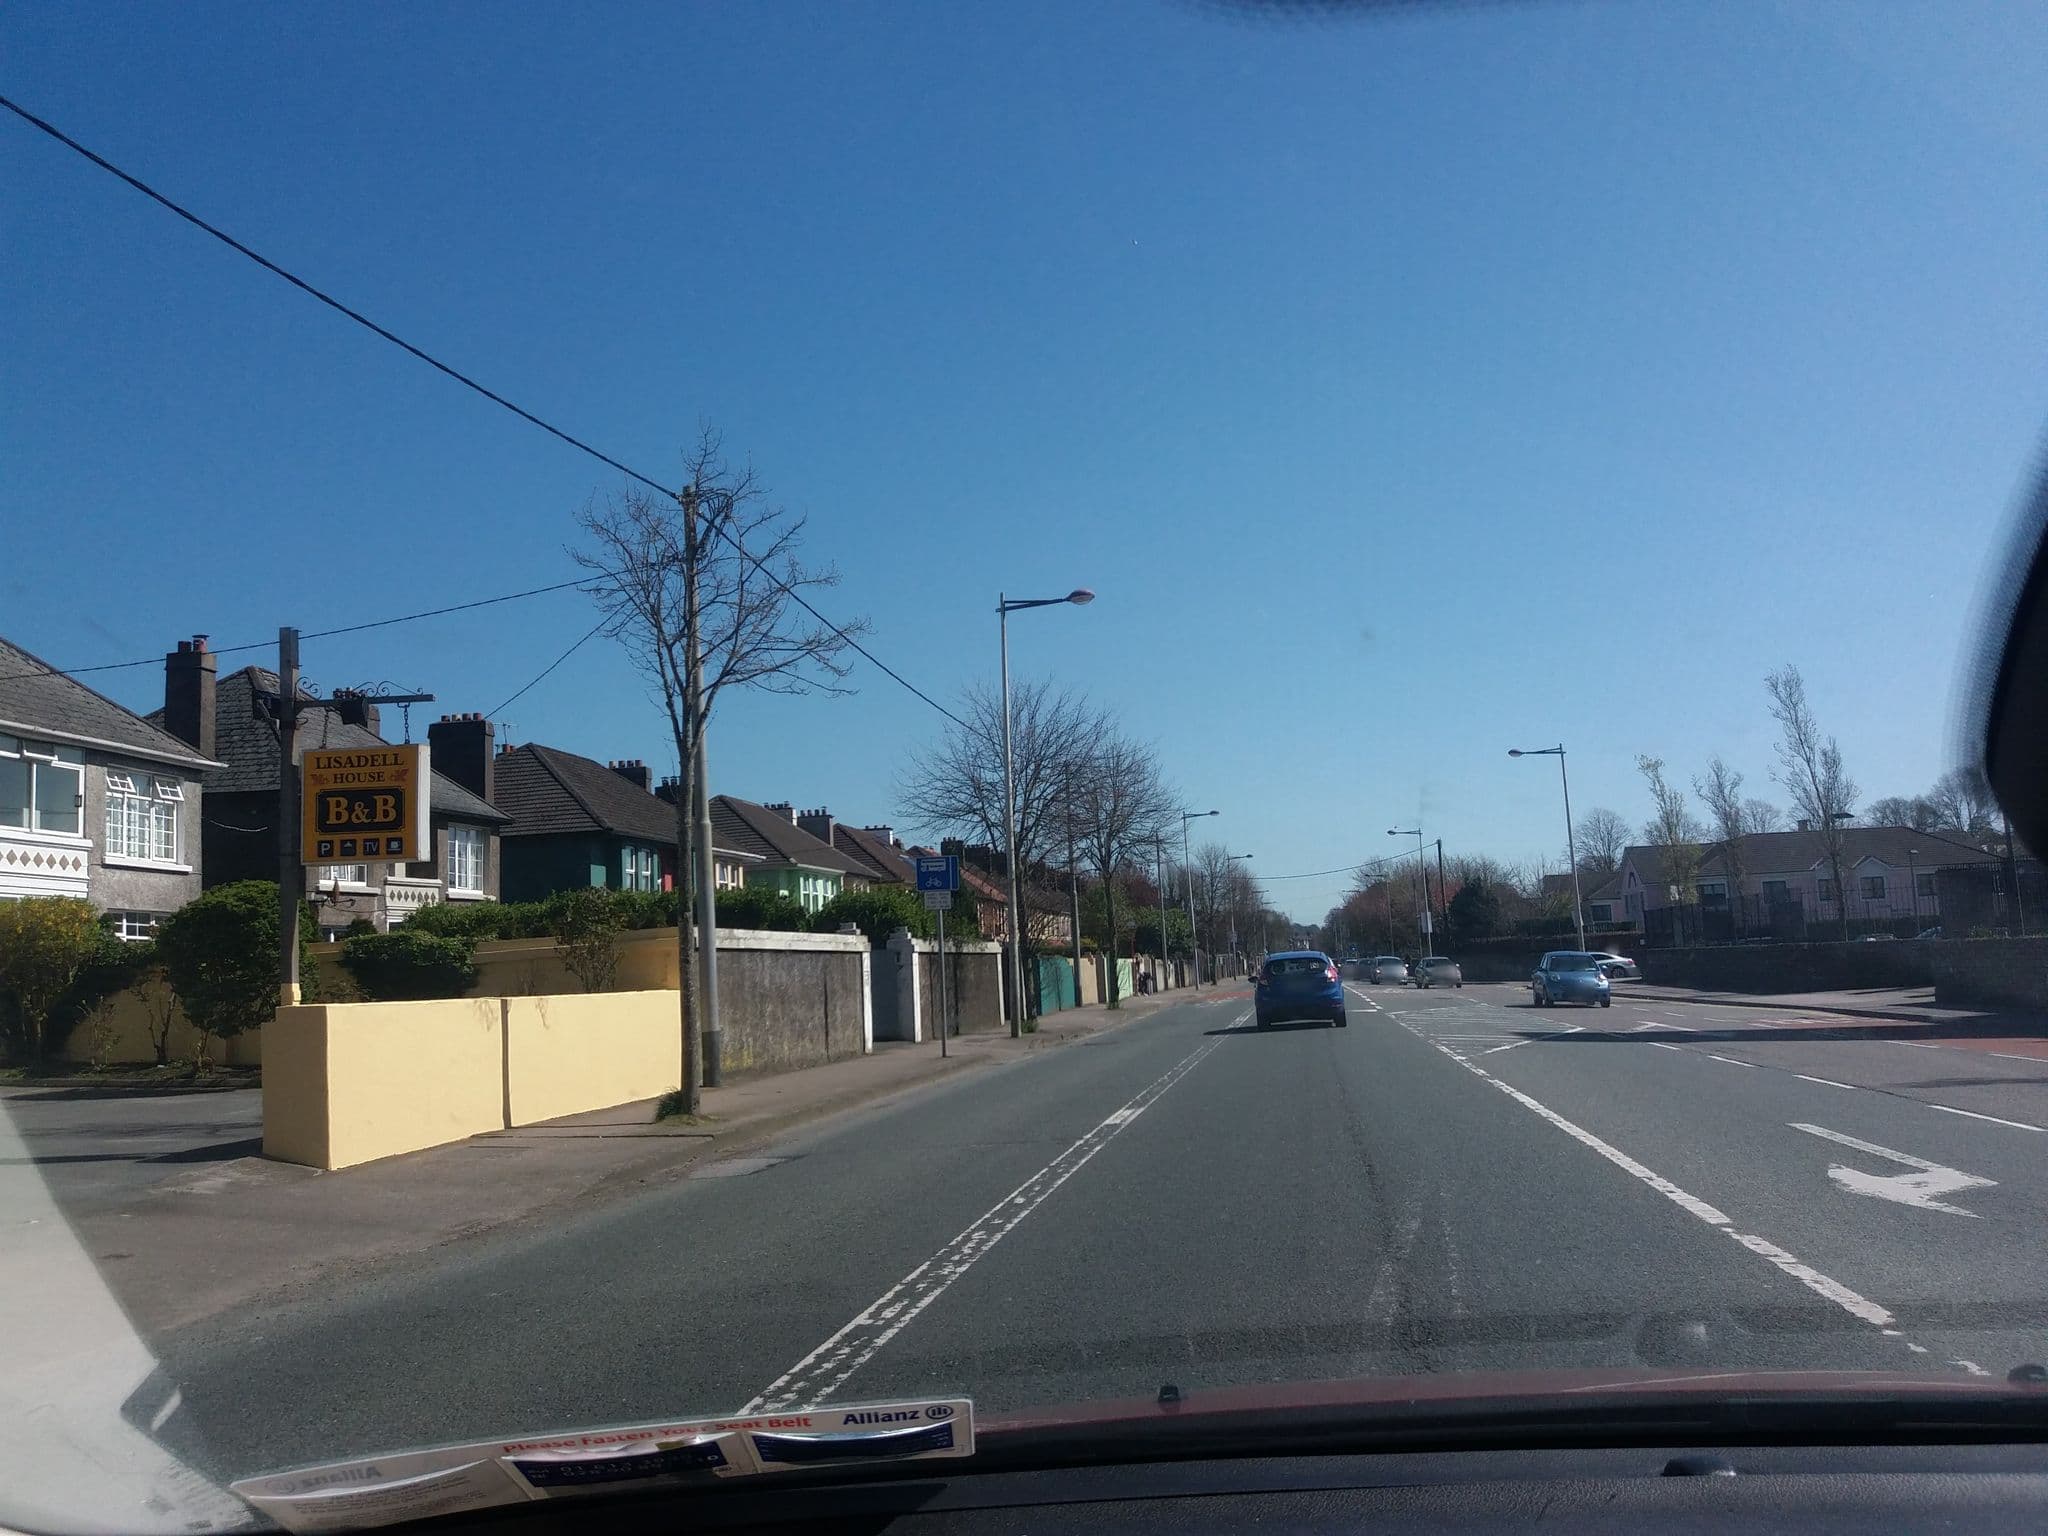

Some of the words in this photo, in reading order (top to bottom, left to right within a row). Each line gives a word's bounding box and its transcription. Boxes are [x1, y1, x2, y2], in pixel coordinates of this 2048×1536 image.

[315, 753, 405, 770] LISADELL
[333, 771, 386, 784] HOUSE
[325, 794, 397, 825] B&B
[320, 842, 331, 855] P
[364, 841, 379, 852] TV
[843, 1409, 921, 1426] Allianz
[503, 1439, 577, 1454] Please
[581, 1431, 653, 1445] Fasten
[659, 1426, 708, 1436] Your
[715, 1420, 763, 1431] Seat
[768, 1416, 813, 1429] Belt
